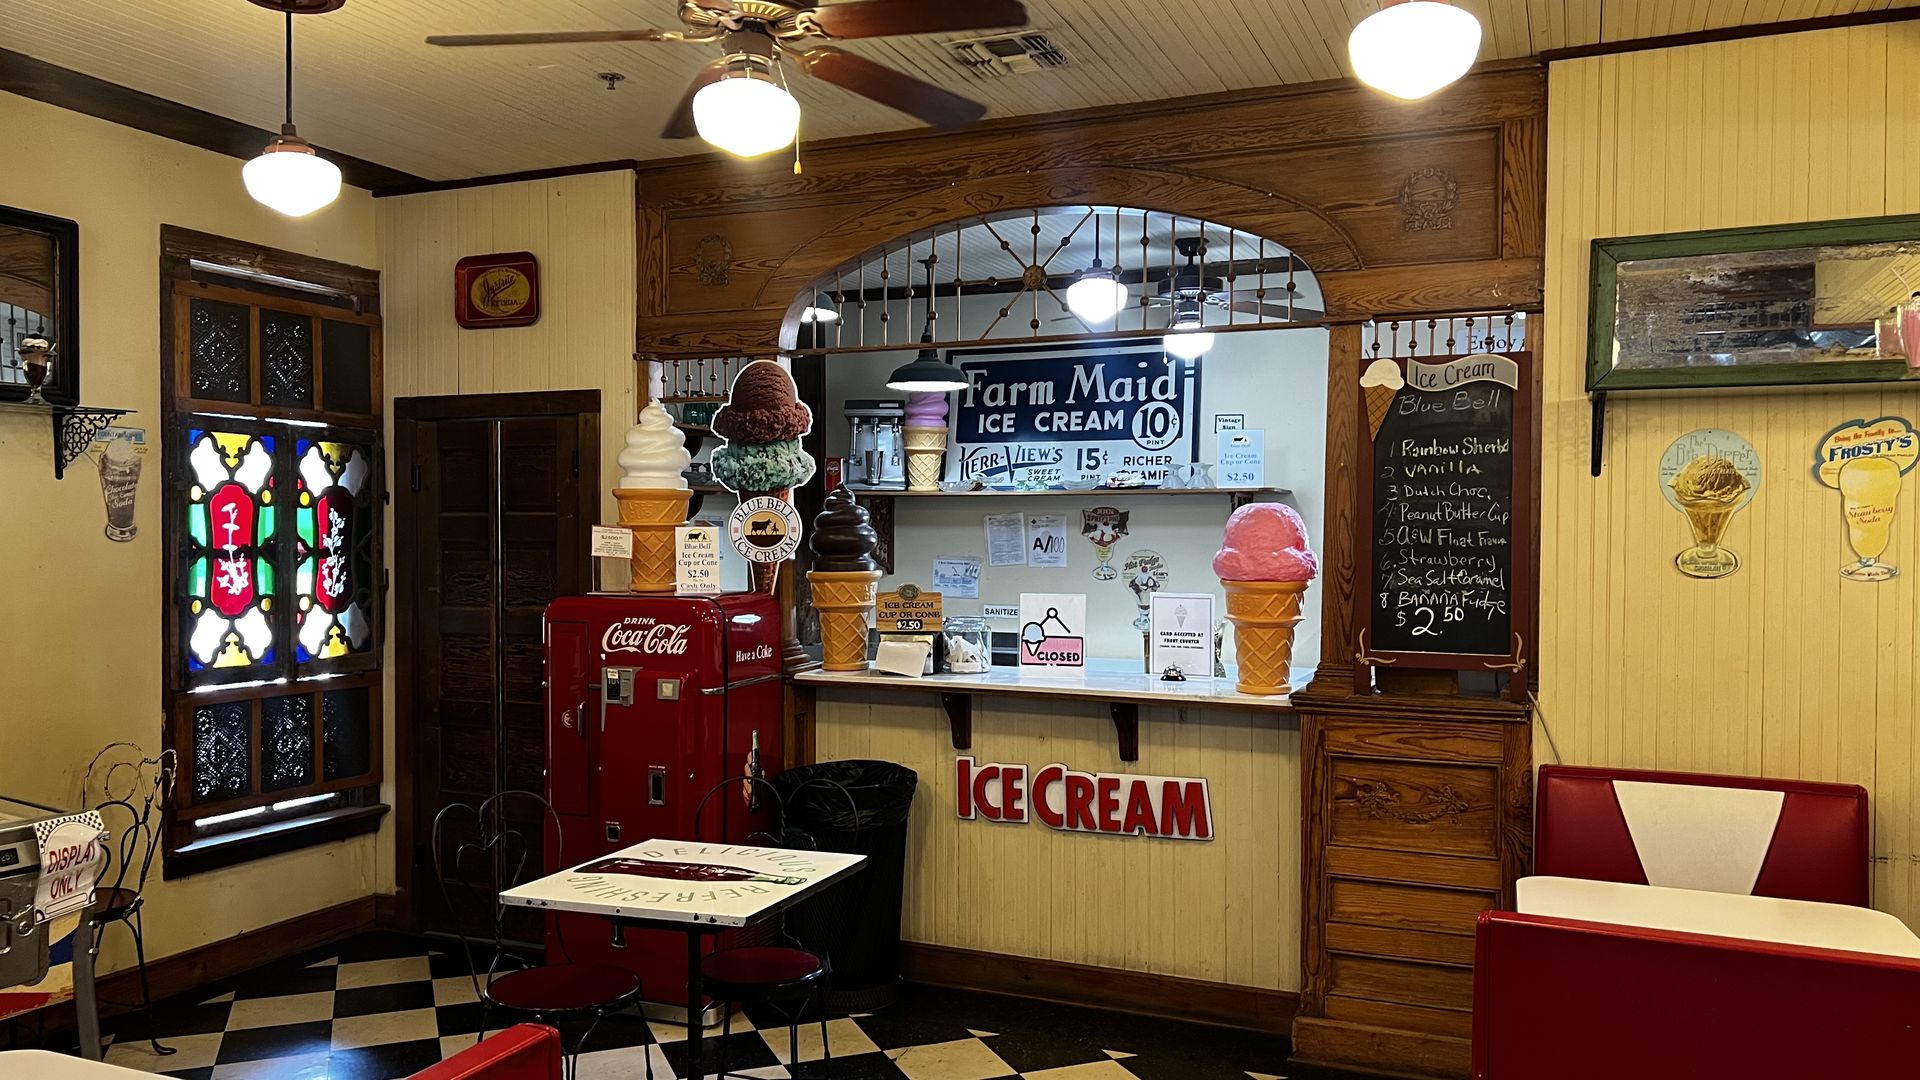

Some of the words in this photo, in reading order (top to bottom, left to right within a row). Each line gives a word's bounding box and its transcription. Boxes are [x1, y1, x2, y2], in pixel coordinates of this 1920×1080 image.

[964, 369, 1055, 407] Farm
[1065, 360, 1177, 404] Maid
[1415, 365, 1437, 388] Ice
[1444, 362, 1495, 385] Cream
[1398, 394, 1446, 415] Blue
[1452, 388, 1500, 410] Bell
[978, 413, 1015, 433] ICE
[1034, 410, 1124, 432] CREAM
[1402, 438, 1458, 457] Rainbow
[1124, 456, 1172, 466] RICHER
[1227, 472, 1254, 481] $2.50
[1387, 485, 1398, 500] 3
[1404, 485, 1445, 497] Dutch
[734, 498, 764, 522] BLUE
[766, 498, 793, 522] BELL
[1400, 501, 1442, 522] Peanut
[1442, 502, 1486, 522] Butter
[1488, 502, 1509, 525] Cup
[1857, 516, 1880, 524] Soda
[734, 536, 752, 558] ICE
[754, 536, 796, 561] CREAM
[1378, 528, 1395, 546] 5
[1399, 548, 1496, 572] Strawberry
[688, 570, 709, 578] $2.50
[1398, 568, 1422, 586] Sea
[1426, 570, 1458, 586] Salt
[1458, 568, 1504, 590] Caramel
[1380, 592, 1389, 608] 8
[1462, 590, 1506, 620] Fudge
[896, 621, 920, 629] $2.50
[602, 622, 691, 655] Coca-Cola
[736, 651, 750, 662] Have
[752, 652, 756, 660] a
[756, 645, 772, 659] Coke
[1037, 652, 1080, 661] CLOSED
[958, 760, 1024, 820] ICE
[1033, 767, 1208, 837] CREAM
[643, 847, 816, 873] DELICIOUS
[50, 868, 84, 899] ONLY
[567, 876, 770, 902] REFRESHING
